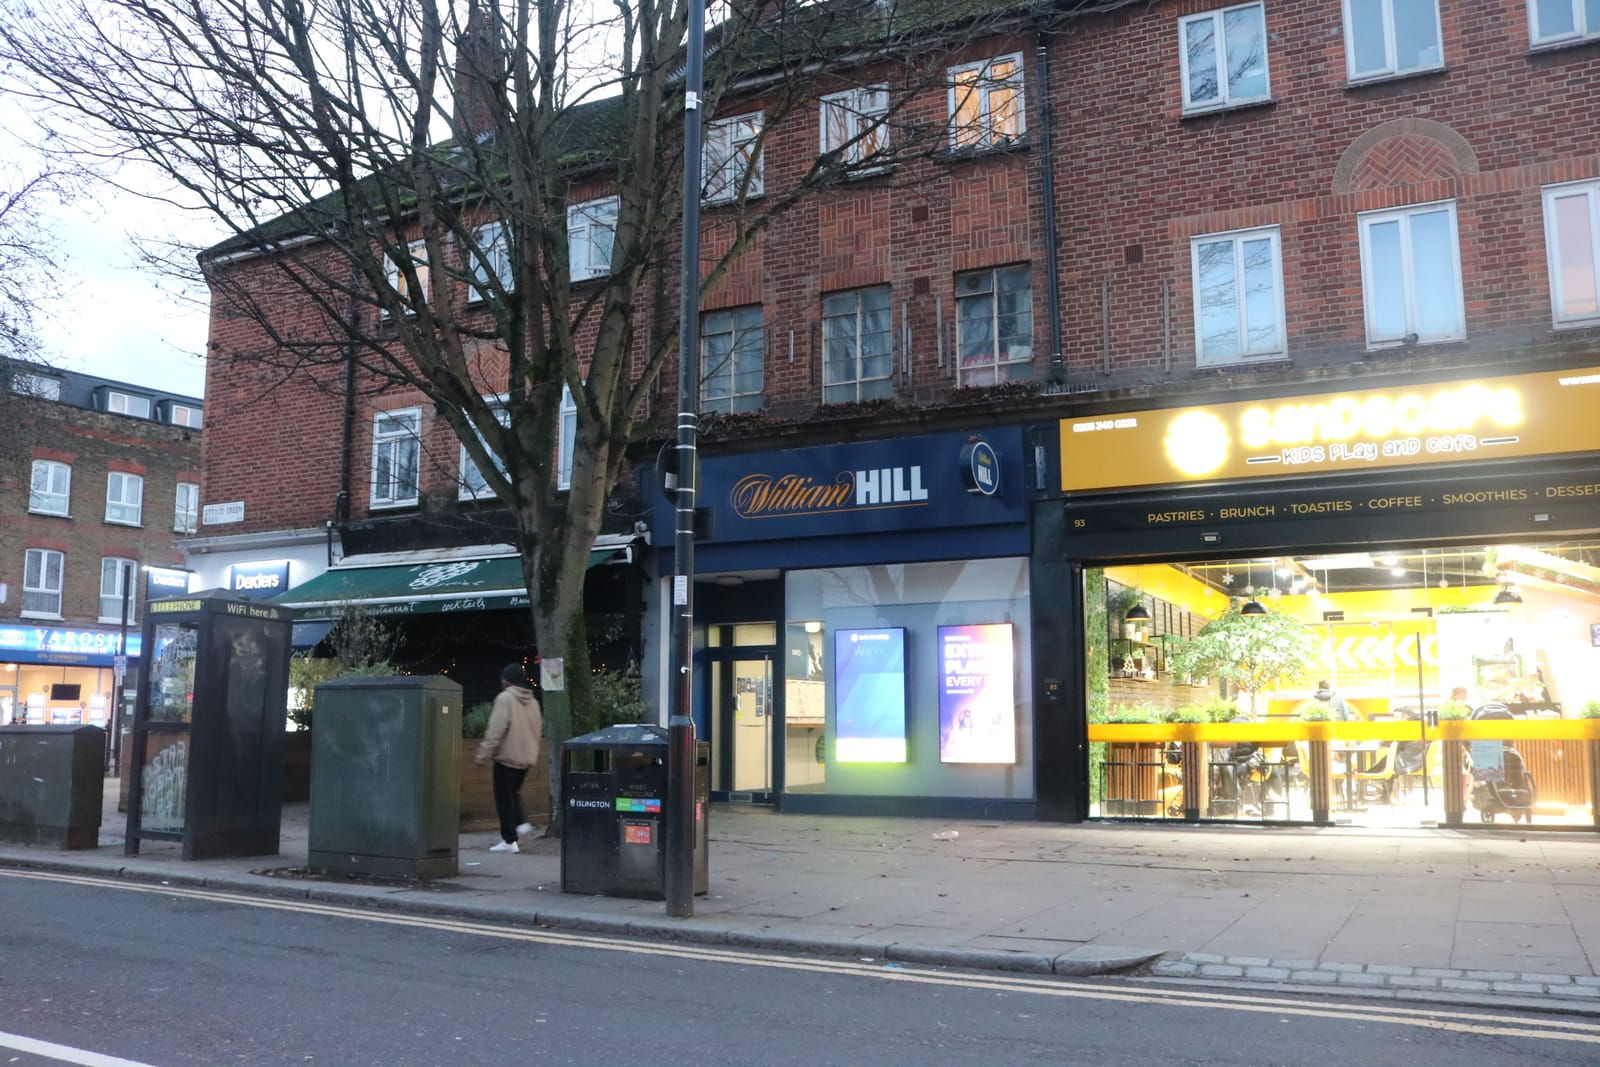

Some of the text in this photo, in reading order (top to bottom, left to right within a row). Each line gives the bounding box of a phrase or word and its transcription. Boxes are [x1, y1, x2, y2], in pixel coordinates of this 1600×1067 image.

[978, 464, 993, 486] HILL
[730, 466, 928, 519] William HILL
[1147, 510, 1205, 523] PASTRIES
[1220, 506, 1275, 518] BRUNCH
[1290, 500, 1353, 514] TOASTIES
[1368, 496, 1423, 509] COFFEE
[1442, 489, 1528, 504] SMOOTHIES
[1074, 519, 1086, 527] 93
[235, 573, 280, 590] Dexters
[227, 603, 268, 618] WiFi here
[946, 676, 983, 687] EVERY
[576, 800, 610, 809] ISLINGTON
